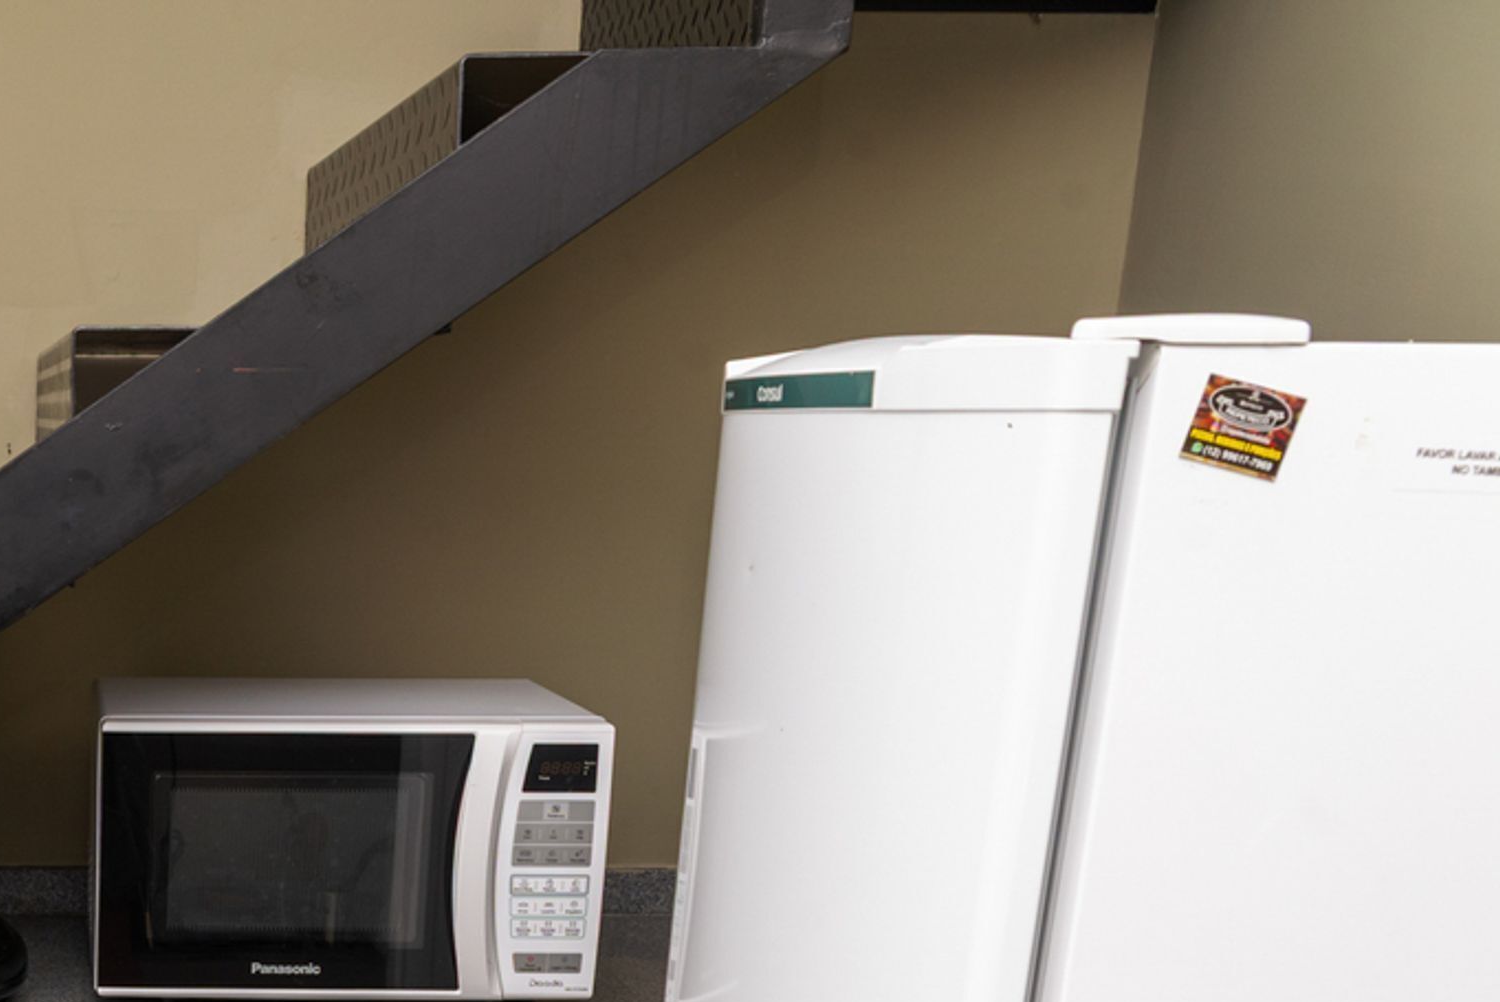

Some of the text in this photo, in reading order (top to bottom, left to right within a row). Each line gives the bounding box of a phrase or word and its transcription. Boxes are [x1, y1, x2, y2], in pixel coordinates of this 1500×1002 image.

[1416, 447, 1495, 461] FAVOR LAVAR
[1451, 464, 1470, 475] NO
[251, 962, 321, 975] Panasonic
